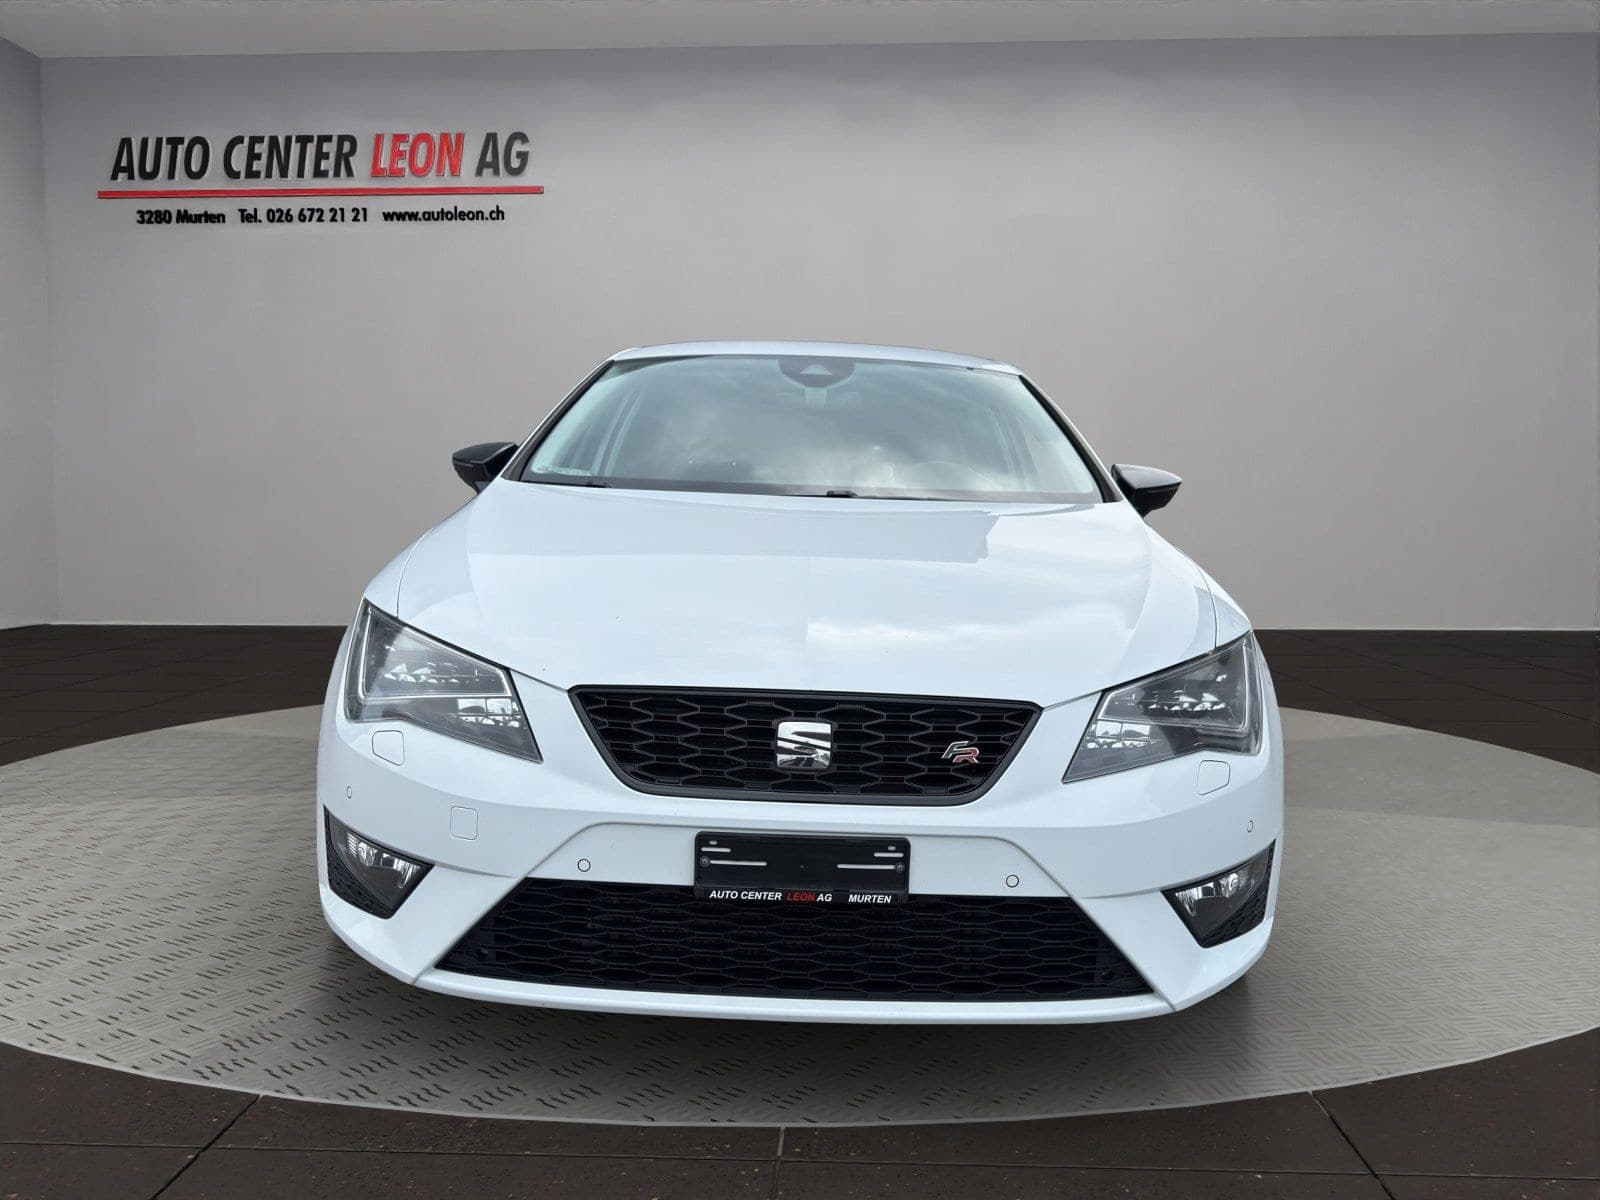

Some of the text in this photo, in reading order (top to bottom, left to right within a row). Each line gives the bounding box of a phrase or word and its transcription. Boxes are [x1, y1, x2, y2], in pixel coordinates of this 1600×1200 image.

[110, 131, 530, 182] AUTO CENTER LEON AG
[136, 205, 506, 225] 3280 Murten Tel. 026 672 21 21 www.autoleon.ch
[941, 740, 980, 764] FR
[709, 889, 893, 904] AUTO CENTER LEON AG MURTEN
